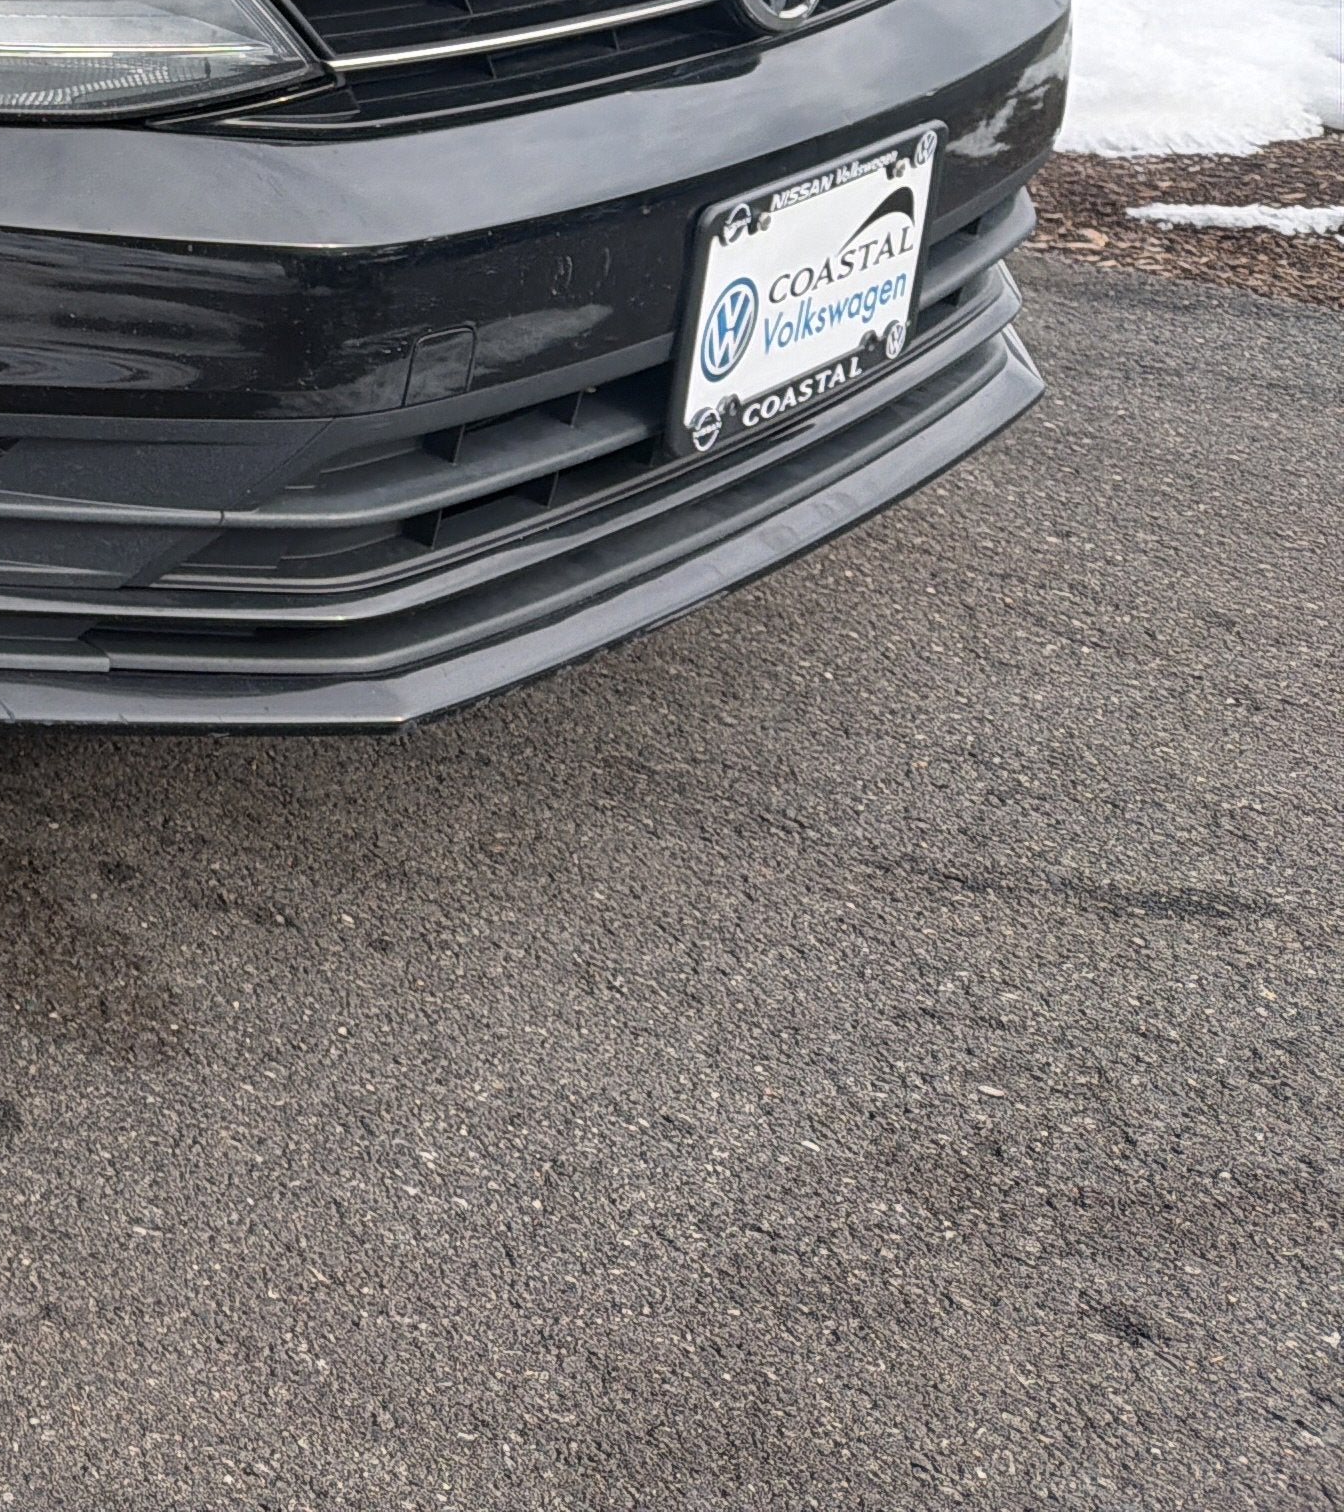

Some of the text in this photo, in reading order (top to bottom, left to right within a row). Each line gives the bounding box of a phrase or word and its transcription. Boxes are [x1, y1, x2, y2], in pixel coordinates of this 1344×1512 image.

[770, 172, 834, 212] NISSAN
[768, 226, 914, 304] COASTAL
[701, 277, 760, 383] VW
[763, 273, 908, 356] Volkswagen
[742, 356, 863, 427] COASTAL
